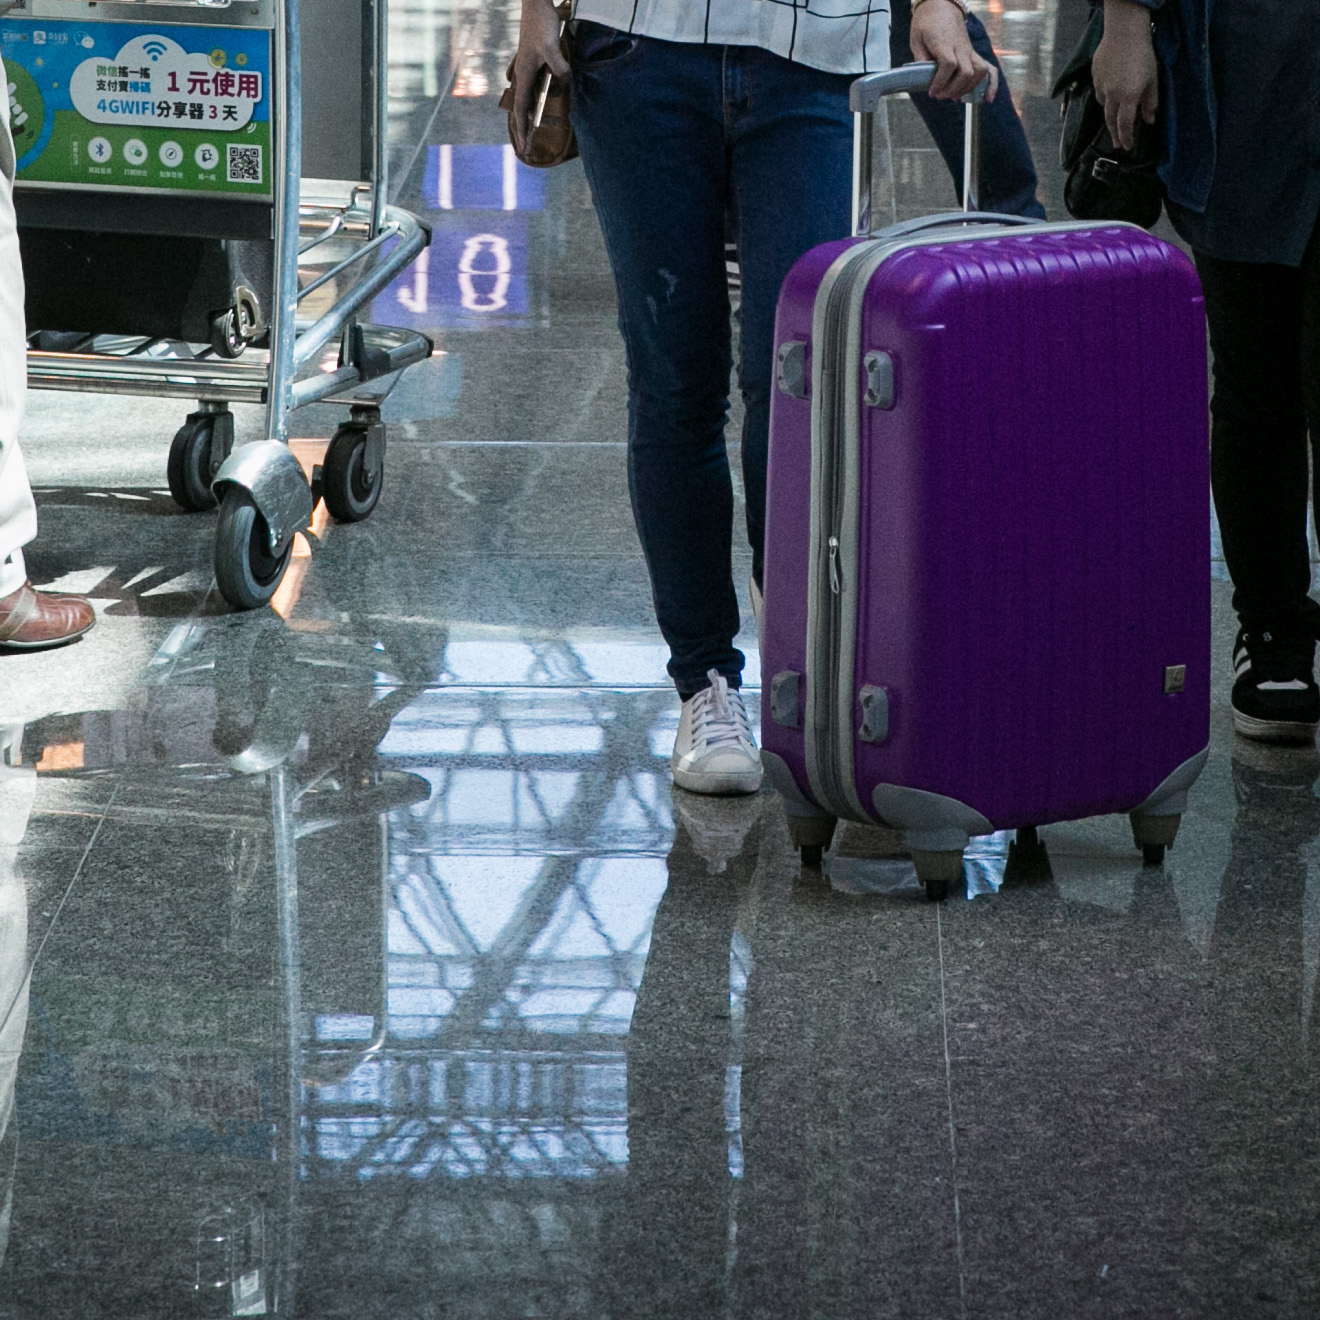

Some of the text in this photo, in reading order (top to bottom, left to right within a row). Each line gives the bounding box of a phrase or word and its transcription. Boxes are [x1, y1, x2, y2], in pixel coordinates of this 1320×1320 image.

[167, 70, 259, 99] 1 元使用
[96, 98, 238, 121] 4GWIFI分享器 3 天
